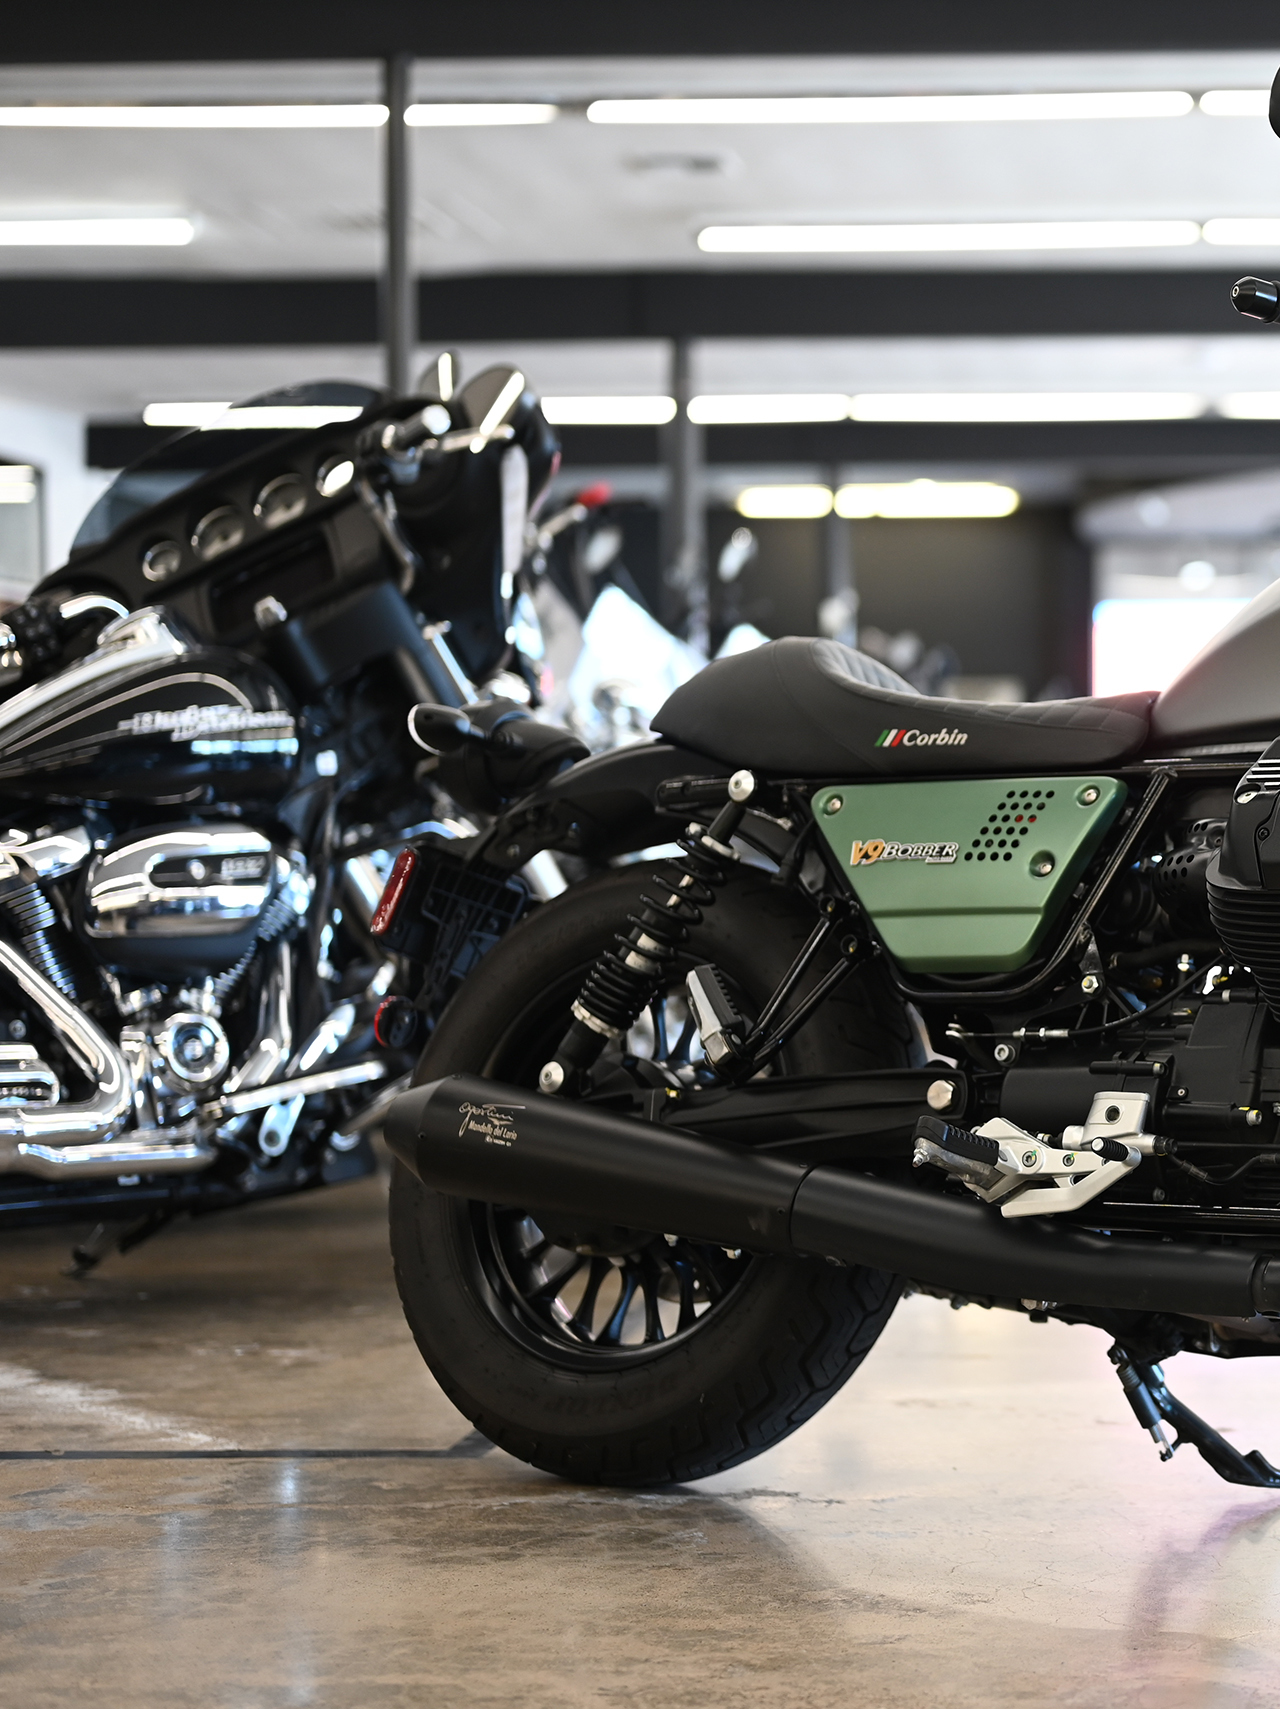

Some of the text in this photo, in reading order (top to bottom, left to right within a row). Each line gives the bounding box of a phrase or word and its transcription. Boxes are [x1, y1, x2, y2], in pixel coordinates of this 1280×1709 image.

[902, 728, 968, 746] Corbin
[850, 839, 958, 866] V9 BOBBER
